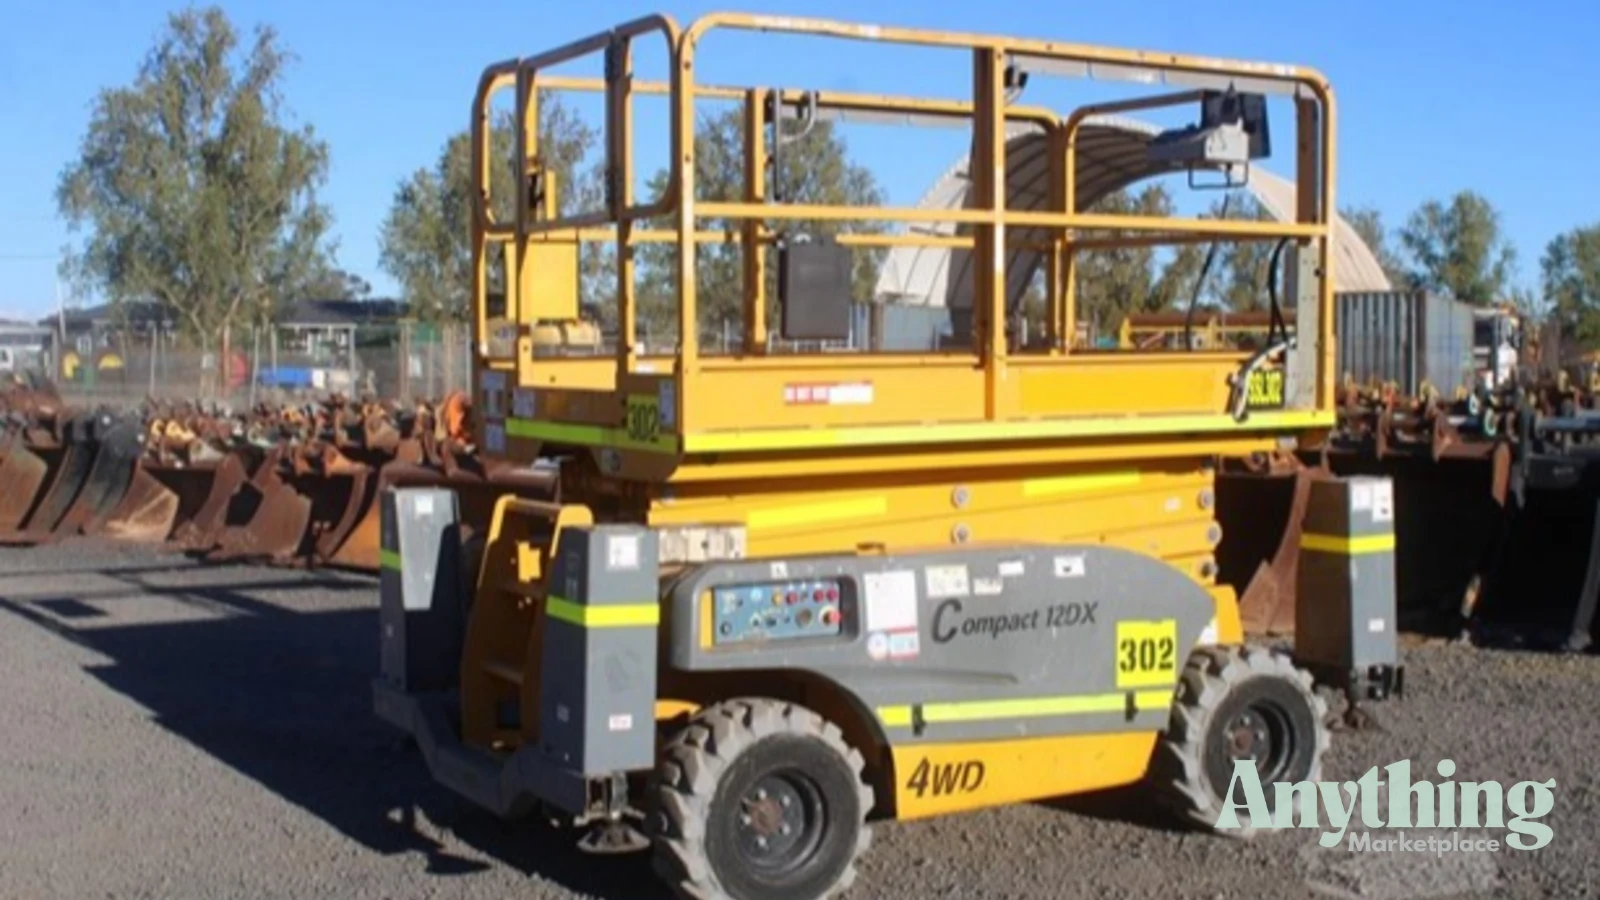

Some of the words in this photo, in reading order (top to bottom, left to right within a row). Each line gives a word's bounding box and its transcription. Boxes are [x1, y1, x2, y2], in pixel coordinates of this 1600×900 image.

[628, 403, 660, 443] 302
[931, 598, 1039, 643] Compact
[1046, 602, 1099, 629] 12DX
[1119, 637, 1175, 673] 302
[906, 757, 986, 798] 4WD
